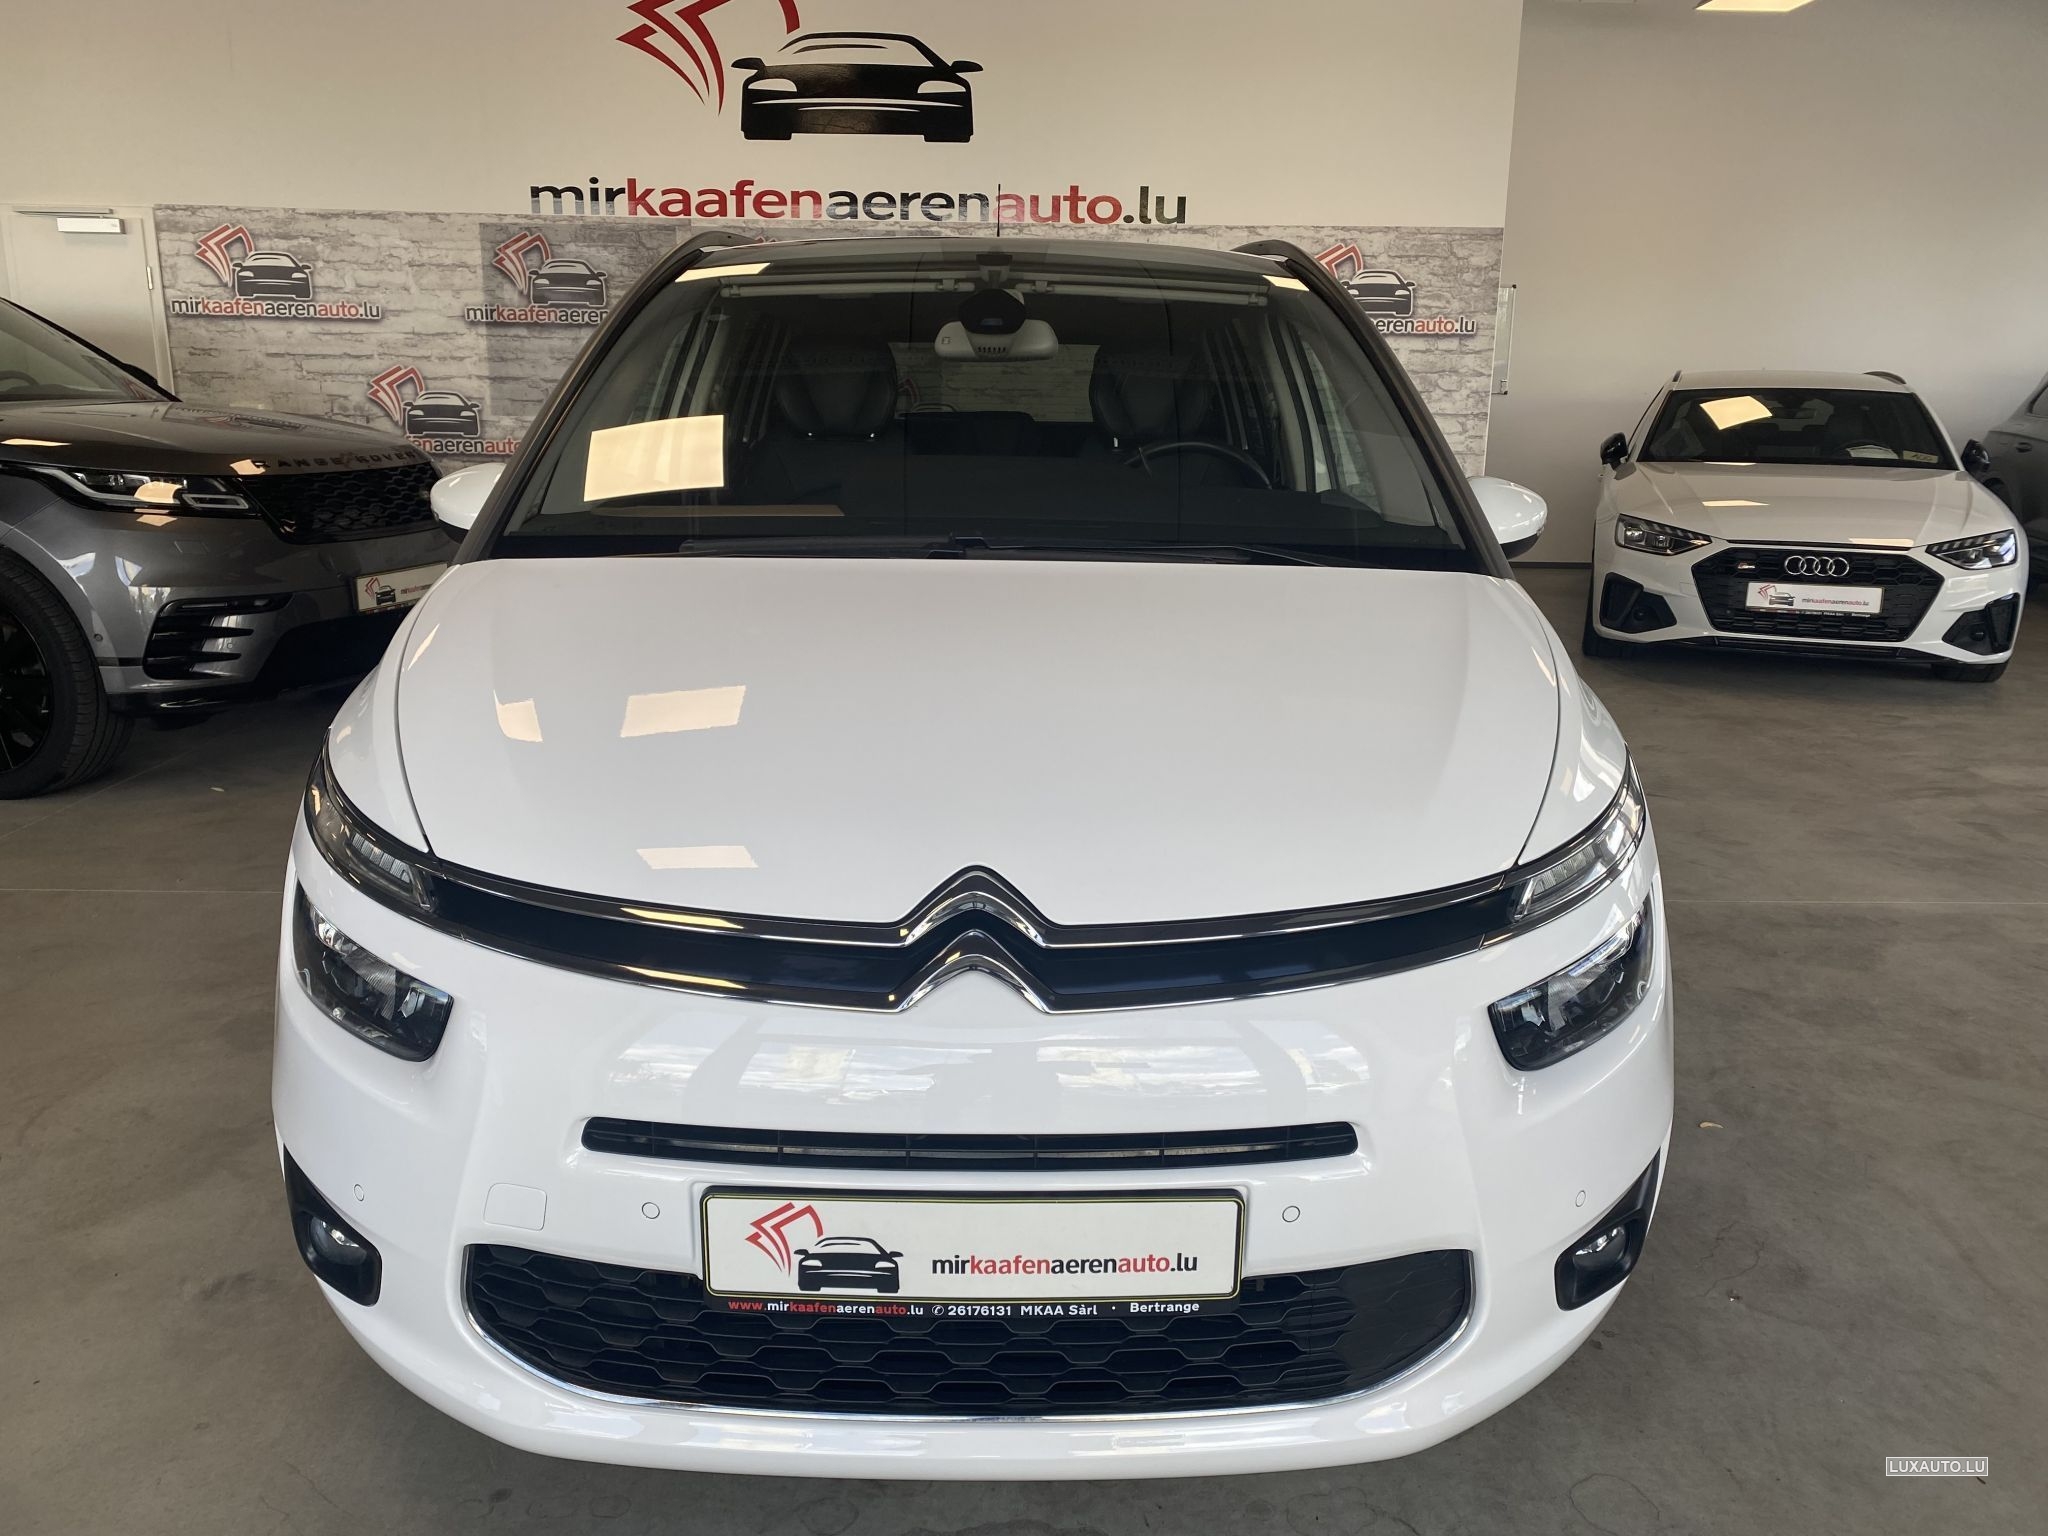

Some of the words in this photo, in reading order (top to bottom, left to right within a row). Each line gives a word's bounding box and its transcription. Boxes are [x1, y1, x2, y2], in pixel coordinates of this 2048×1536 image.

[529, 177, 1187, 224] mirkaafenaerenauto.lu
[171, 296, 380, 319] mirkaafenaerenauto.lu
[931, 1252, 1198, 1275] mirkaafenaerenauto.lu
[728, 1300, 924, 1316] www.mirkaafenaerenauto.lu
[947, 1304, 1012, 1316] 26176131
[1020, 1304, 1064, 1316] MKAA
[1129, 1301, 1201, 1314] Bertrange
